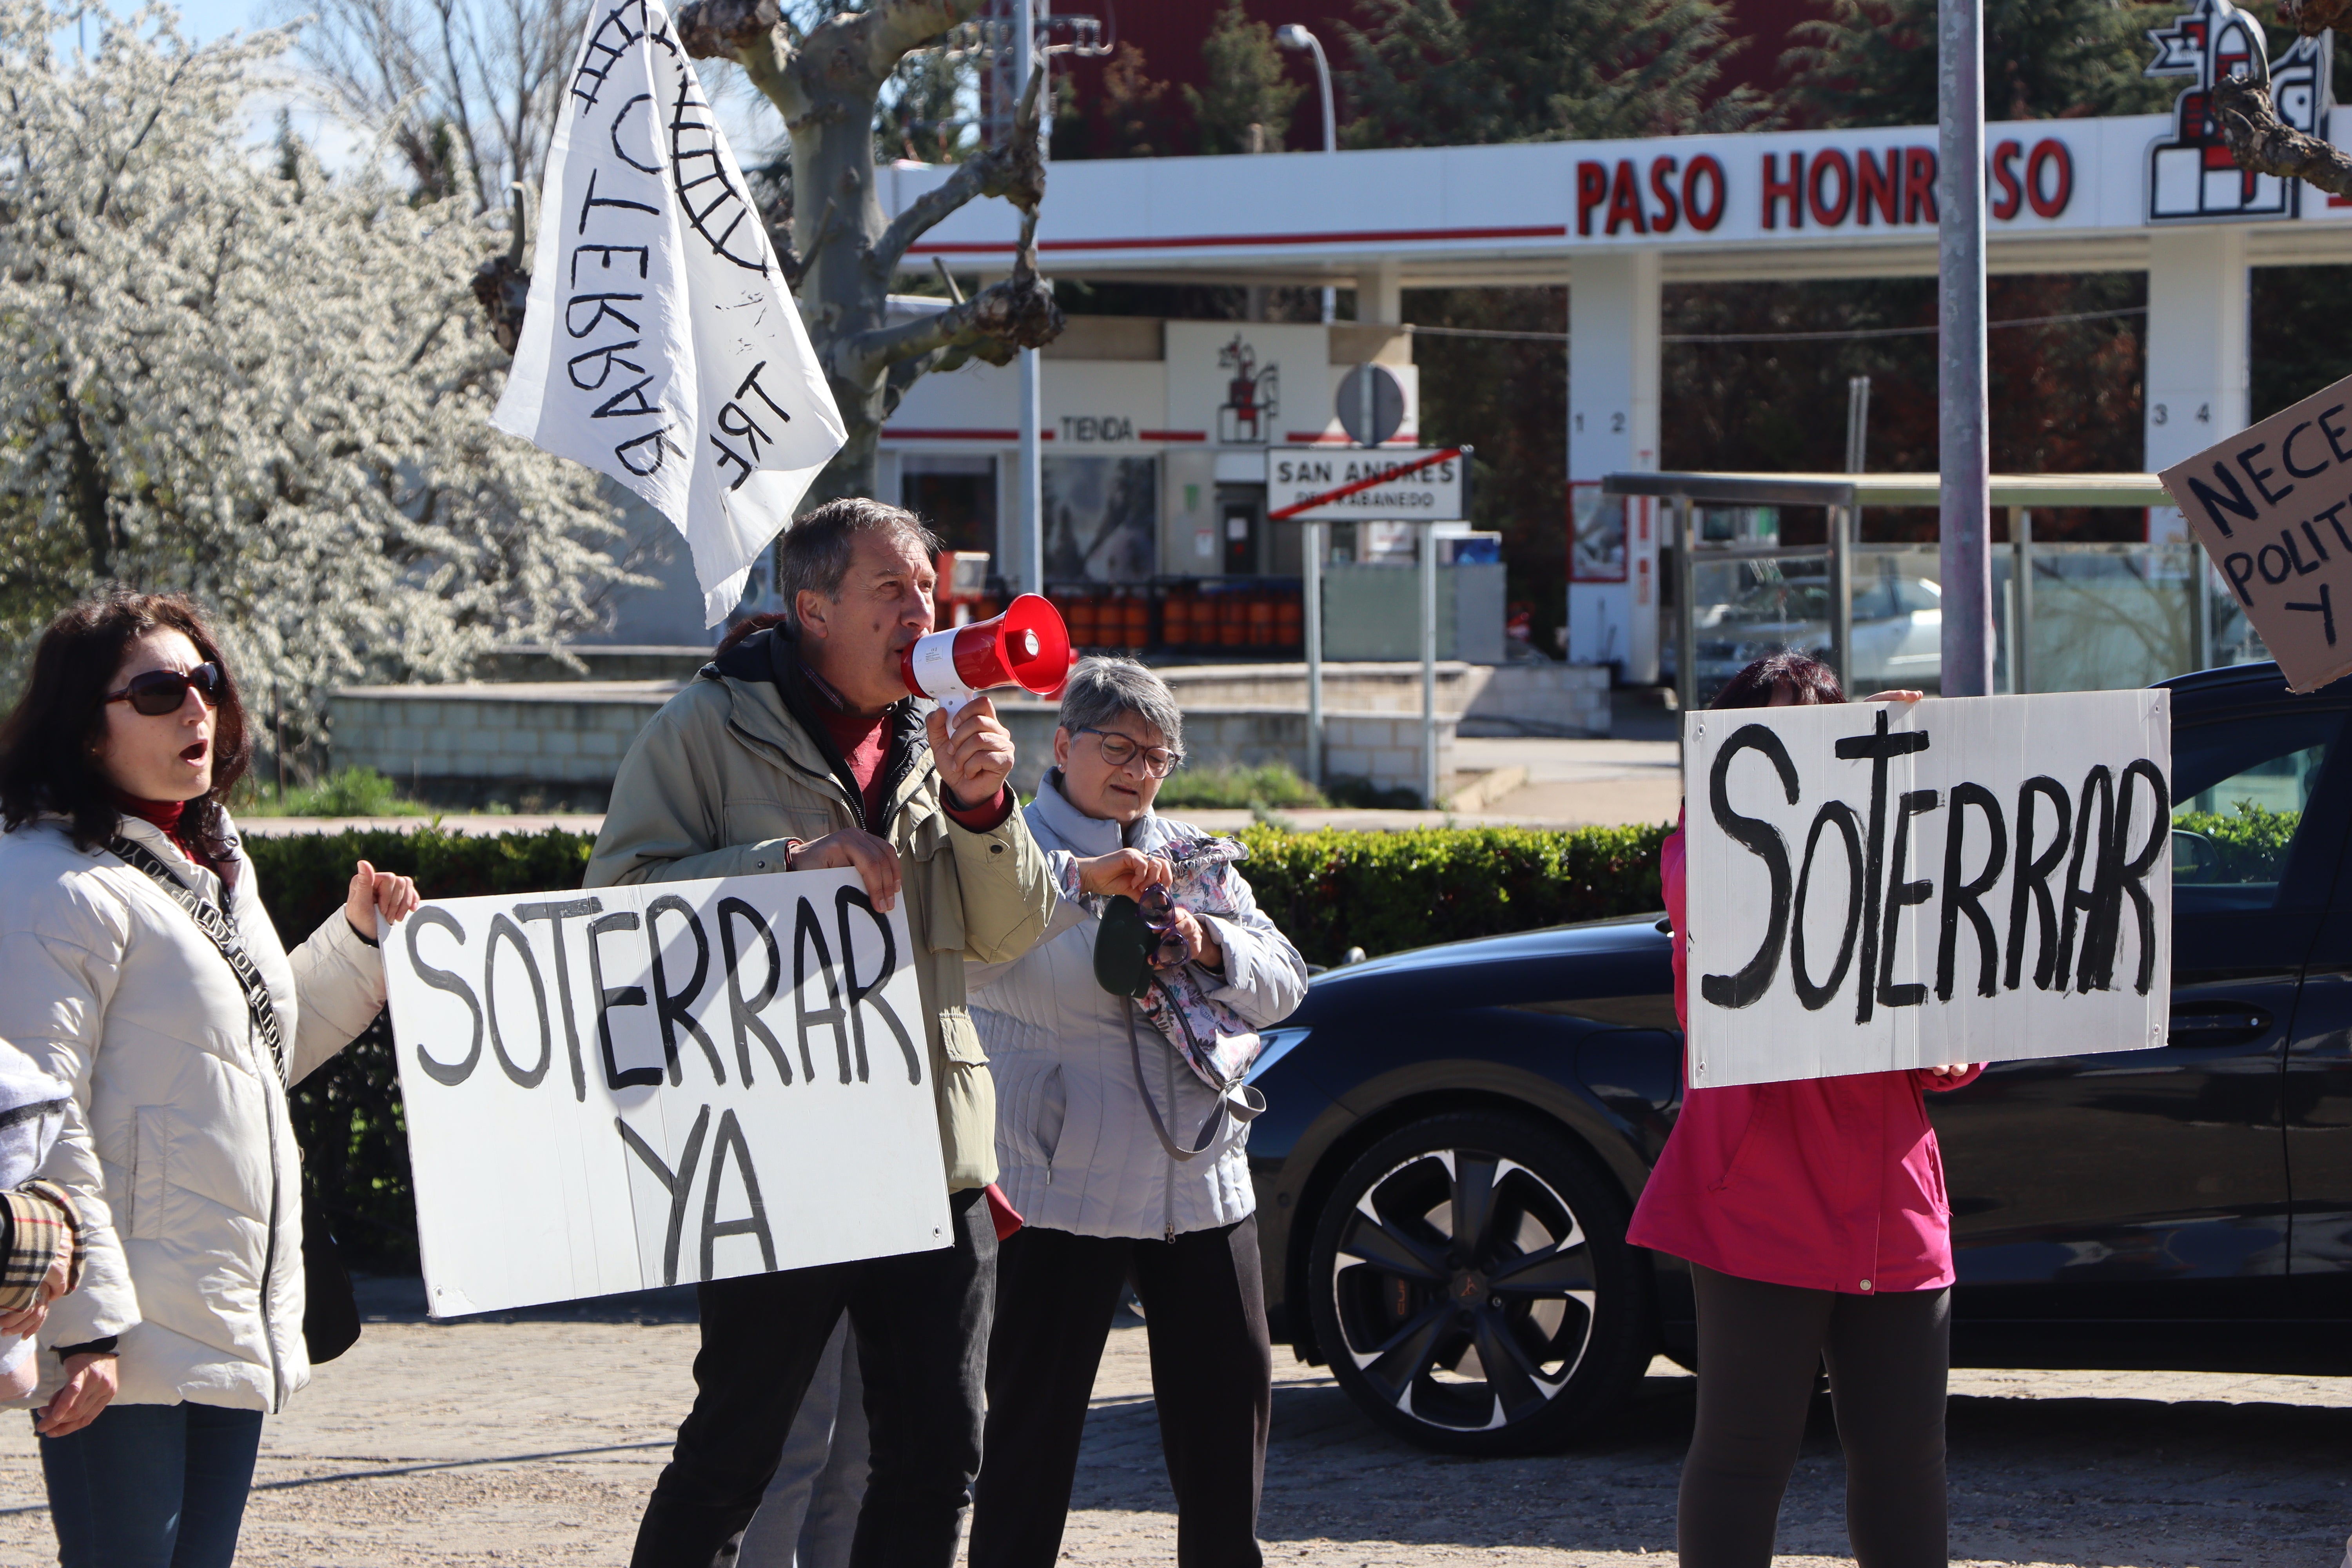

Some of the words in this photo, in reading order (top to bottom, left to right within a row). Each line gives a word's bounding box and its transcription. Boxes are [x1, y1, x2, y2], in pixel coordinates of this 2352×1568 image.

[1577, 155, 1726, 236] PASO
[1762, 137, 2073, 230] HONRSO
[1060, 416, 1134, 441] TIENDA
[1575, 413, 1584, 432] 1
[1611, 412, 1626, 432] 2
[2154, 402, 2168, 425] 3
[2196, 402, 2211, 423] 4
[1278, 460, 1331, 483] SAN
[2188, 404, 2352, 538] NECE
[2224, 493, 2352, 607] POLIT
[2285, 583, 2337, 647] Y
[1702, 710, 2169, 1025] SOTERRAR
[405, 885, 921, 1102] SOTERRAR
[615, 1104, 777, 1286] YA
